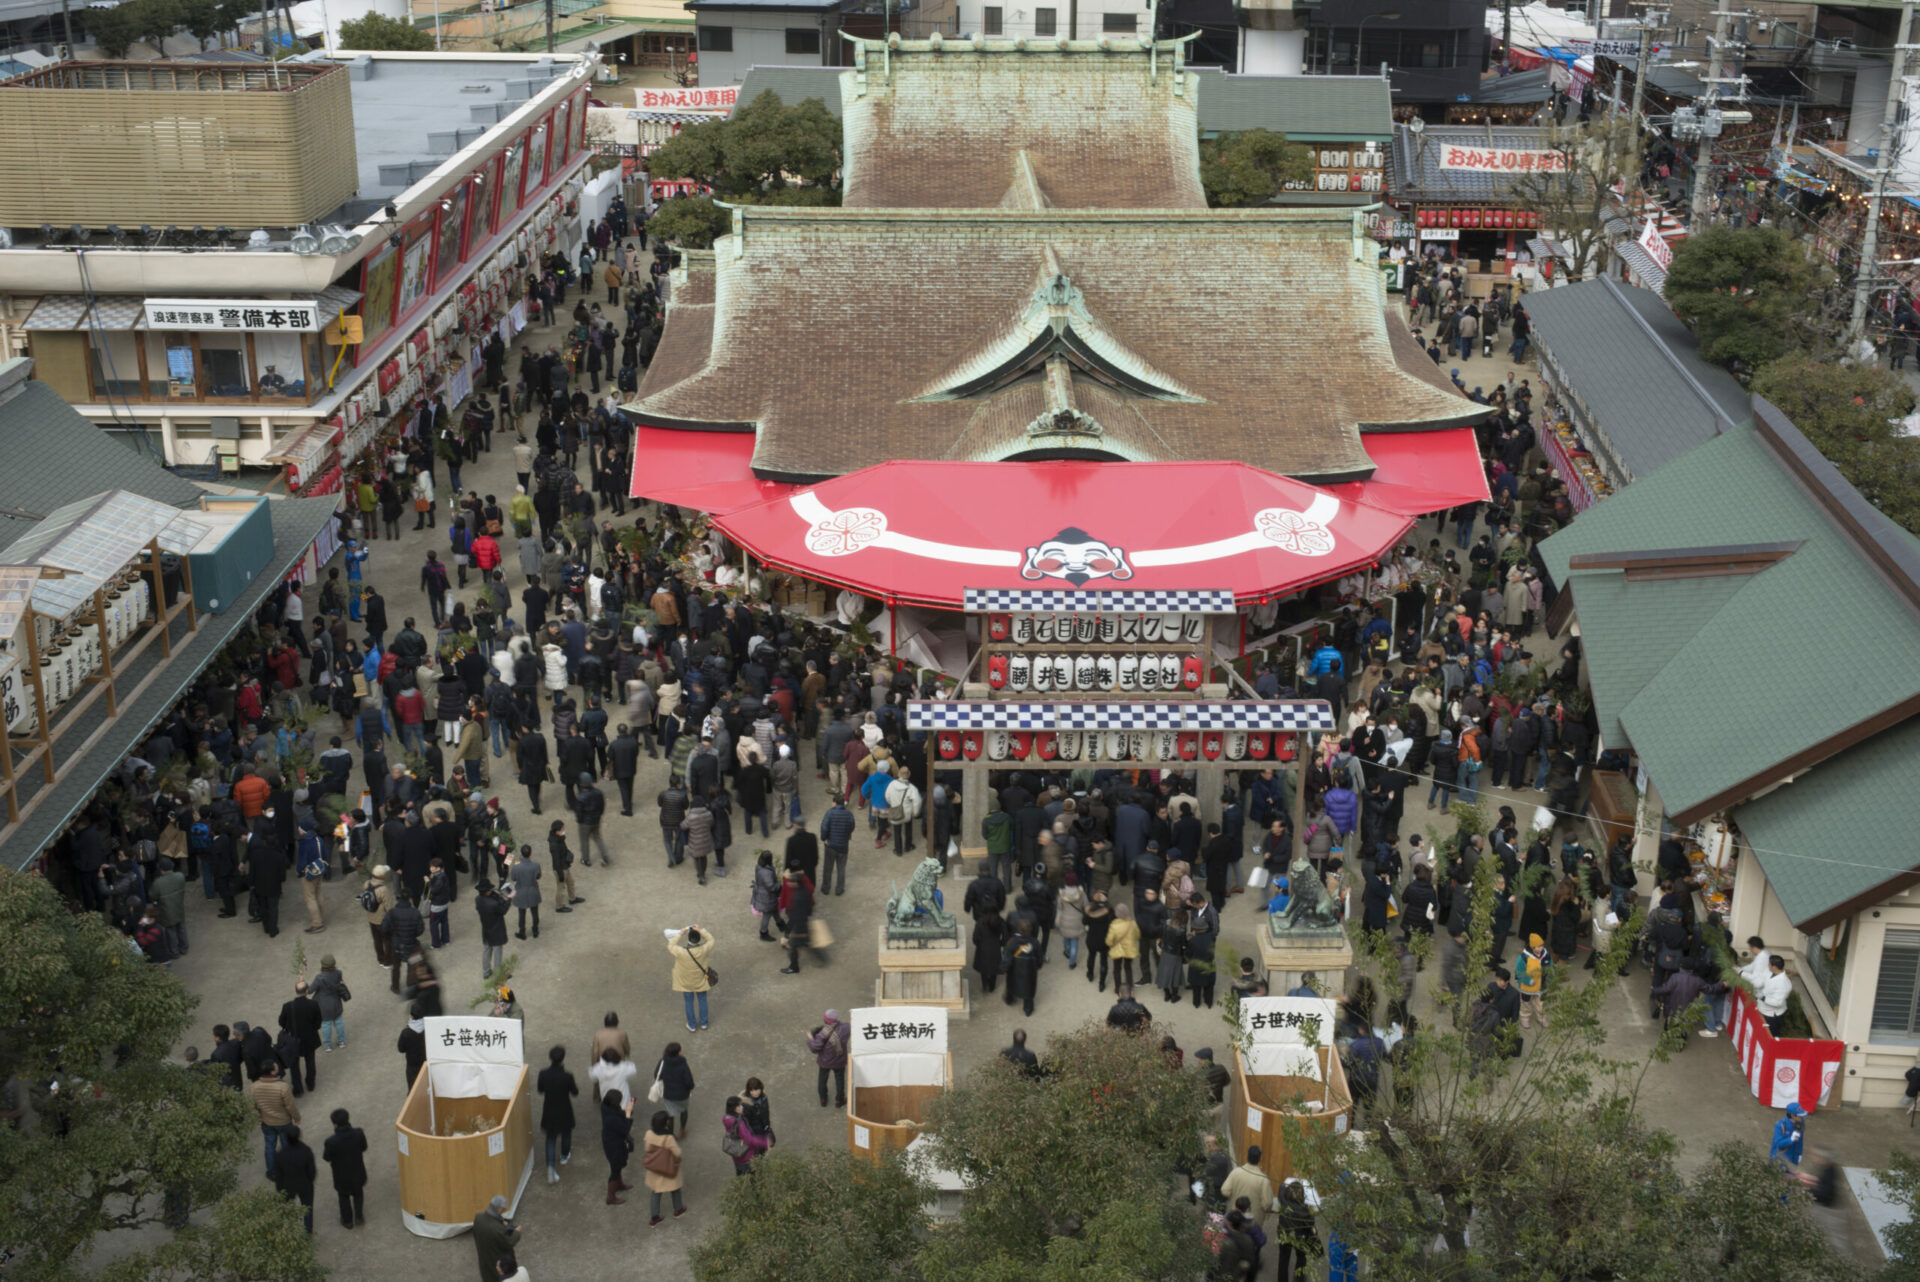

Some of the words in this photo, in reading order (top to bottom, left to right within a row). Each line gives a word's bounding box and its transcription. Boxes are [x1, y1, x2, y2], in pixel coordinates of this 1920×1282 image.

[642, 88, 740, 107] おかえり専用
[218, 309, 311, 328] 警備本部
[1012, 666, 1177, 685] 藤井毛織株式会社
[1250, 1011, 1324, 1030] 古笹納所
[440, 1028, 508, 1049] 古笹納所
[862, 1022, 936, 1040] 古笹納所
